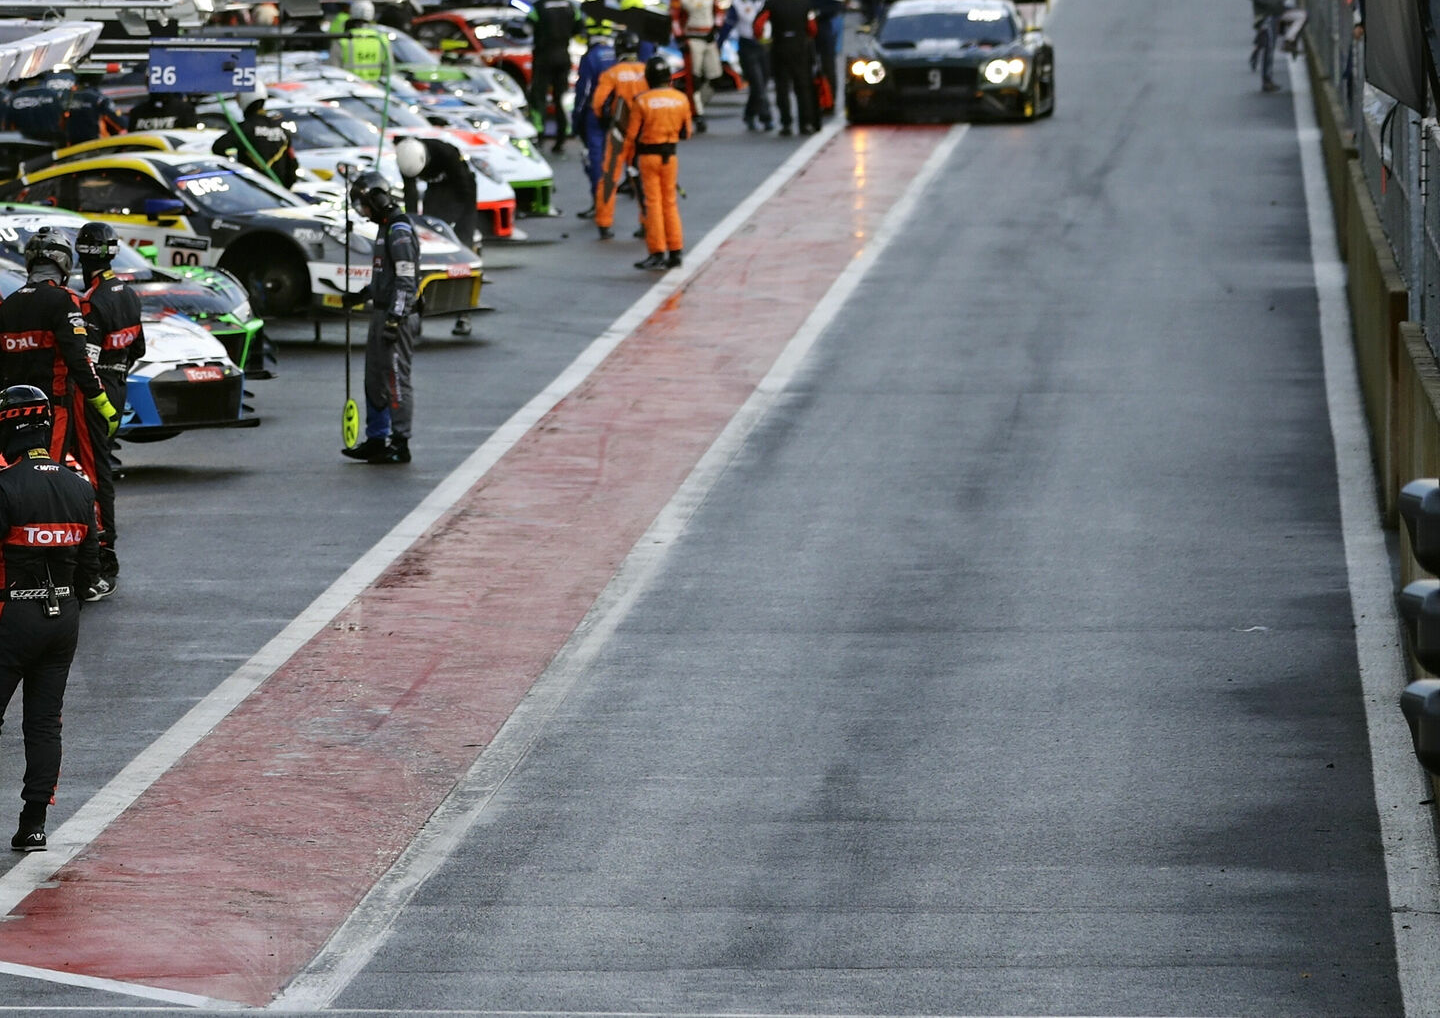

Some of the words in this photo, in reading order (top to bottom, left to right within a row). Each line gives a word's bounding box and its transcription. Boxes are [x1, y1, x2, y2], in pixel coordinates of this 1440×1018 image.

[151, 66, 177, 86] 26
[232, 67, 256, 86] 25
[136, 116, 178, 129] ROWE
[336, 266, 372, 279] ROWE
[187, 369, 221, 380] TOTAL
[23, 526, 82, 544] TOTAL
